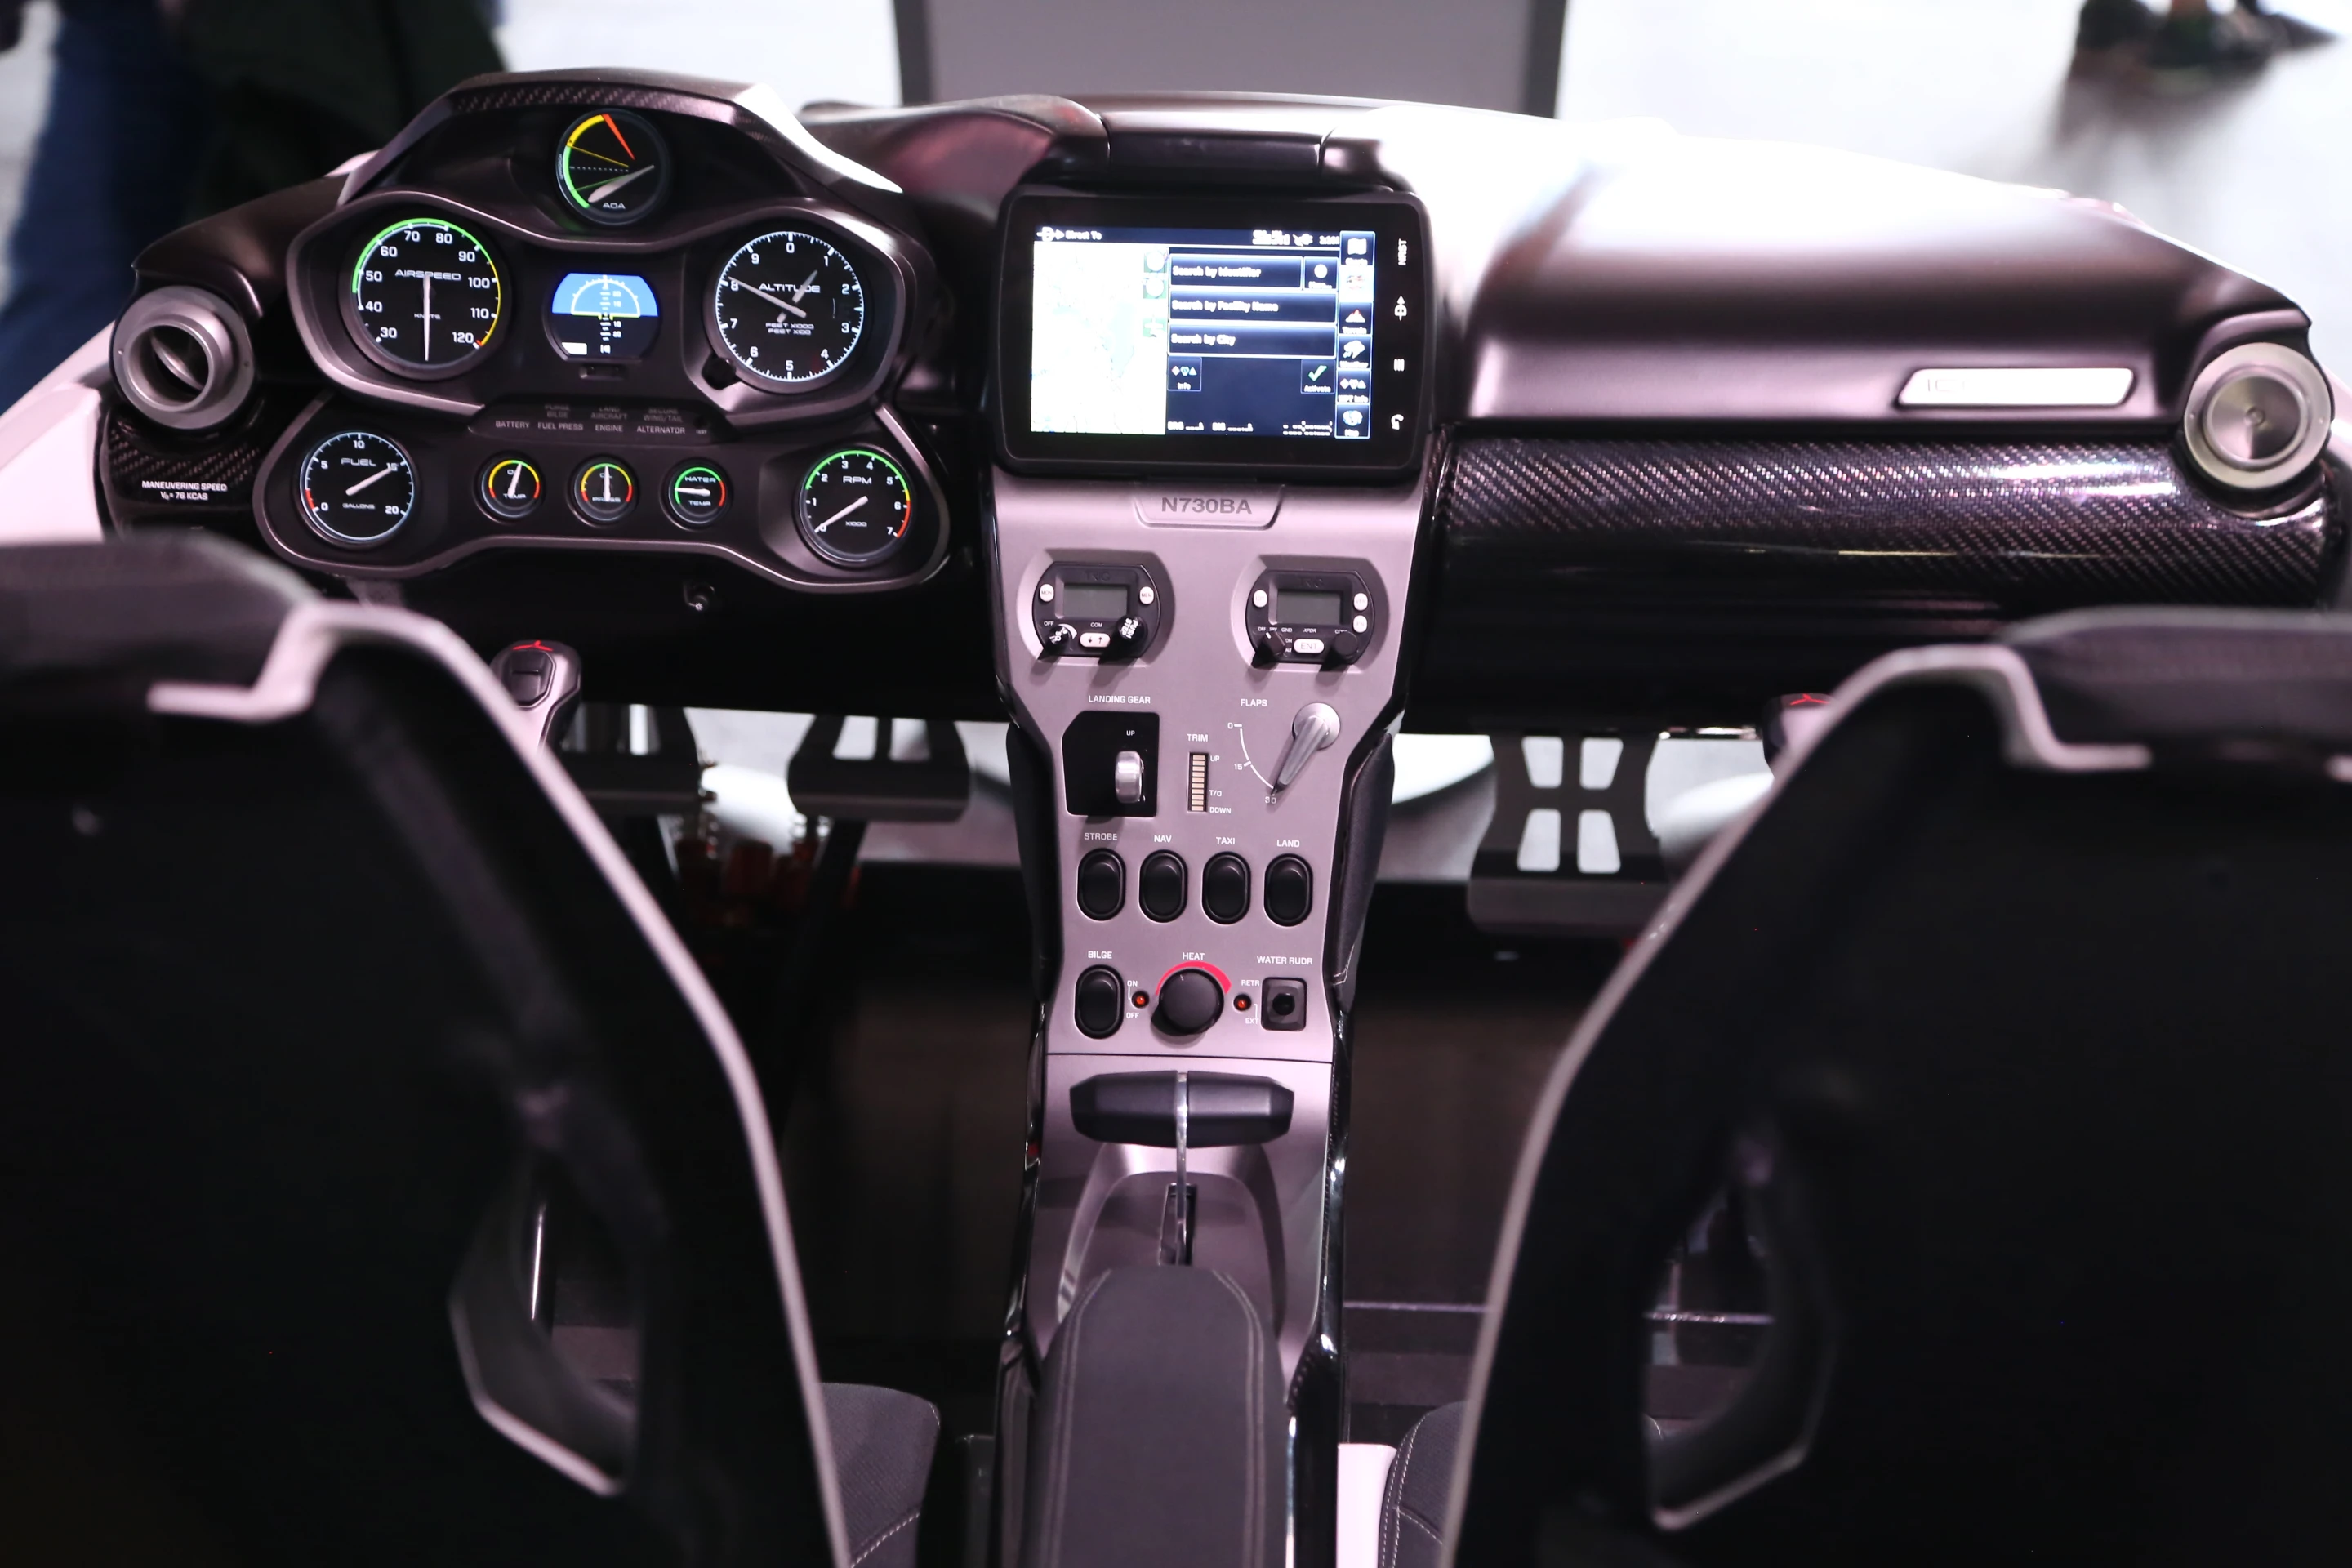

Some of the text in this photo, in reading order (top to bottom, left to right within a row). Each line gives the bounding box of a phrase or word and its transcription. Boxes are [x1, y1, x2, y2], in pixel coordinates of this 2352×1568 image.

[404, 230, 420, 242] 70
[436, 234, 452, 243] 80
[381, 247, 398, 257] 60
[786, 243, 795, 253] 0
[1398, 238, 1407, 265] NRST
[459, 252, 475, 262] 90
[751, 253, 760, 264] 9
[824, 256, 829, 267] 1
[366, 271, 382, 281] 50
[394, 270, 461, 280] AIRSPEED
[1172, 265, 1204, 278] Search
[1205, 266, 1217, 278] by
[468, 277, 490, 288] 100
[731, 281, 738, 291] 8
[759, 283, 821, 293] ALTITUDE
[842, 284, 849, 294] 2
[365, 301, 382, 312] 40
[1171, 300, 1203, 310] Search
[1205, 300, 1217, 312] by
[470, 308, 489, 318] 110
[730, 318, 737, 329] 7
[841, 323, 849, 333] 3
[381, 327, 397, 338] 30
[452, 332, 474, 343] 120
[1171, 334, 1236, 346] Search by City
[750, 346, 759, 357] 6
[821, 349, 829, 359] 4
[786, 360, 794, 371] 5
[637, 425, 685, 434] ALTERNATOR
[353, 440, 365, 449] 10
[321, 461, 328, 469] 5
[341, 457, 376, 466] FUEL
[841, 461, 849, 469] 3
[866, 461, 873, 470] 4
[822, 474, 828, 482] 2
[843, 475, 872, 484] RPM
[887, 477, 893, 485] 5
[142, 481, 227, 492] MANEUVERING SPEED
[175, 492, 185, 500] 76
[321, 502, 328, 511] 0
[813, 497, 817, 506] 1
[894, 501, 901, 510] 6
[1161, 497, 1252, 514] N730BA
[385, 506, 399, 514] 20
[887, 527, 893, 535] 7
[1089, 695, 1151, 704] LANDING GEAR
[1241, 699, 1267, 707] FLAPS
[1187, 733, 1208, 742] TRIM
[1085, 832, 1117, 841] STROBE
[1154, 835, 1172, 843] NAV
[1216, 837, 1235, 845] TAXI
[1277, 840, 1300, 848] LAND
[1088, 951, 1112, 960] BILGE
[1183, 952, 1205, 960] HEAT
[1257, 956, 1313, 965] WATER RUDR
